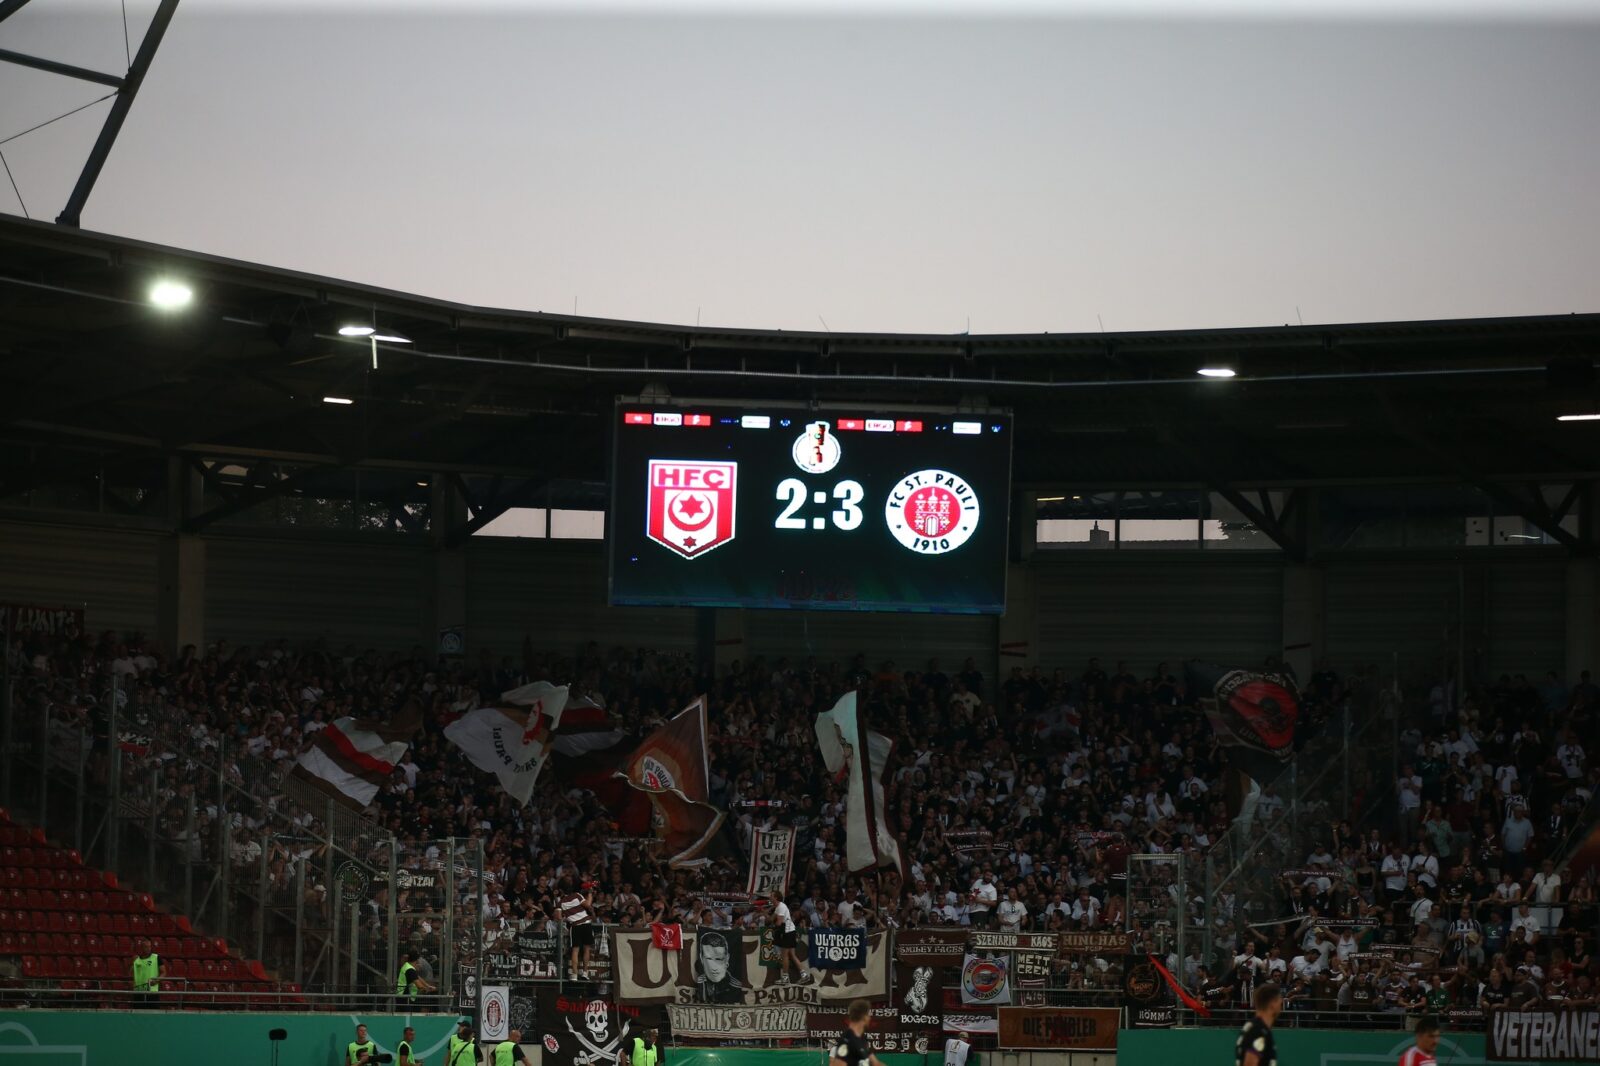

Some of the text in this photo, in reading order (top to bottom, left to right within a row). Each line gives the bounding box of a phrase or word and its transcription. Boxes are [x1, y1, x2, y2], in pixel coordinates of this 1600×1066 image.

[657, 468, 726, 487] HFC
[890, 473, 975, 510] FC ST. PAULI
[775, 478, 864, 531] 2:3
[913, 538, 950, 551] 1910
[815, 933, 860, 947] ULTRAS
[975, 934, 1053, 948] SZENARIO KAOS
[1017, 954, 1050, 966] METT
[1017, 965, 1050, 976] CREW
[754, 986, 818, 1004] PAULI
[672, 1007, 732, 1031] ENFANTS
[901, 1014, 940, 1025] BOGEYS
[1493, 1010, 1600, 1058] VETERANE
